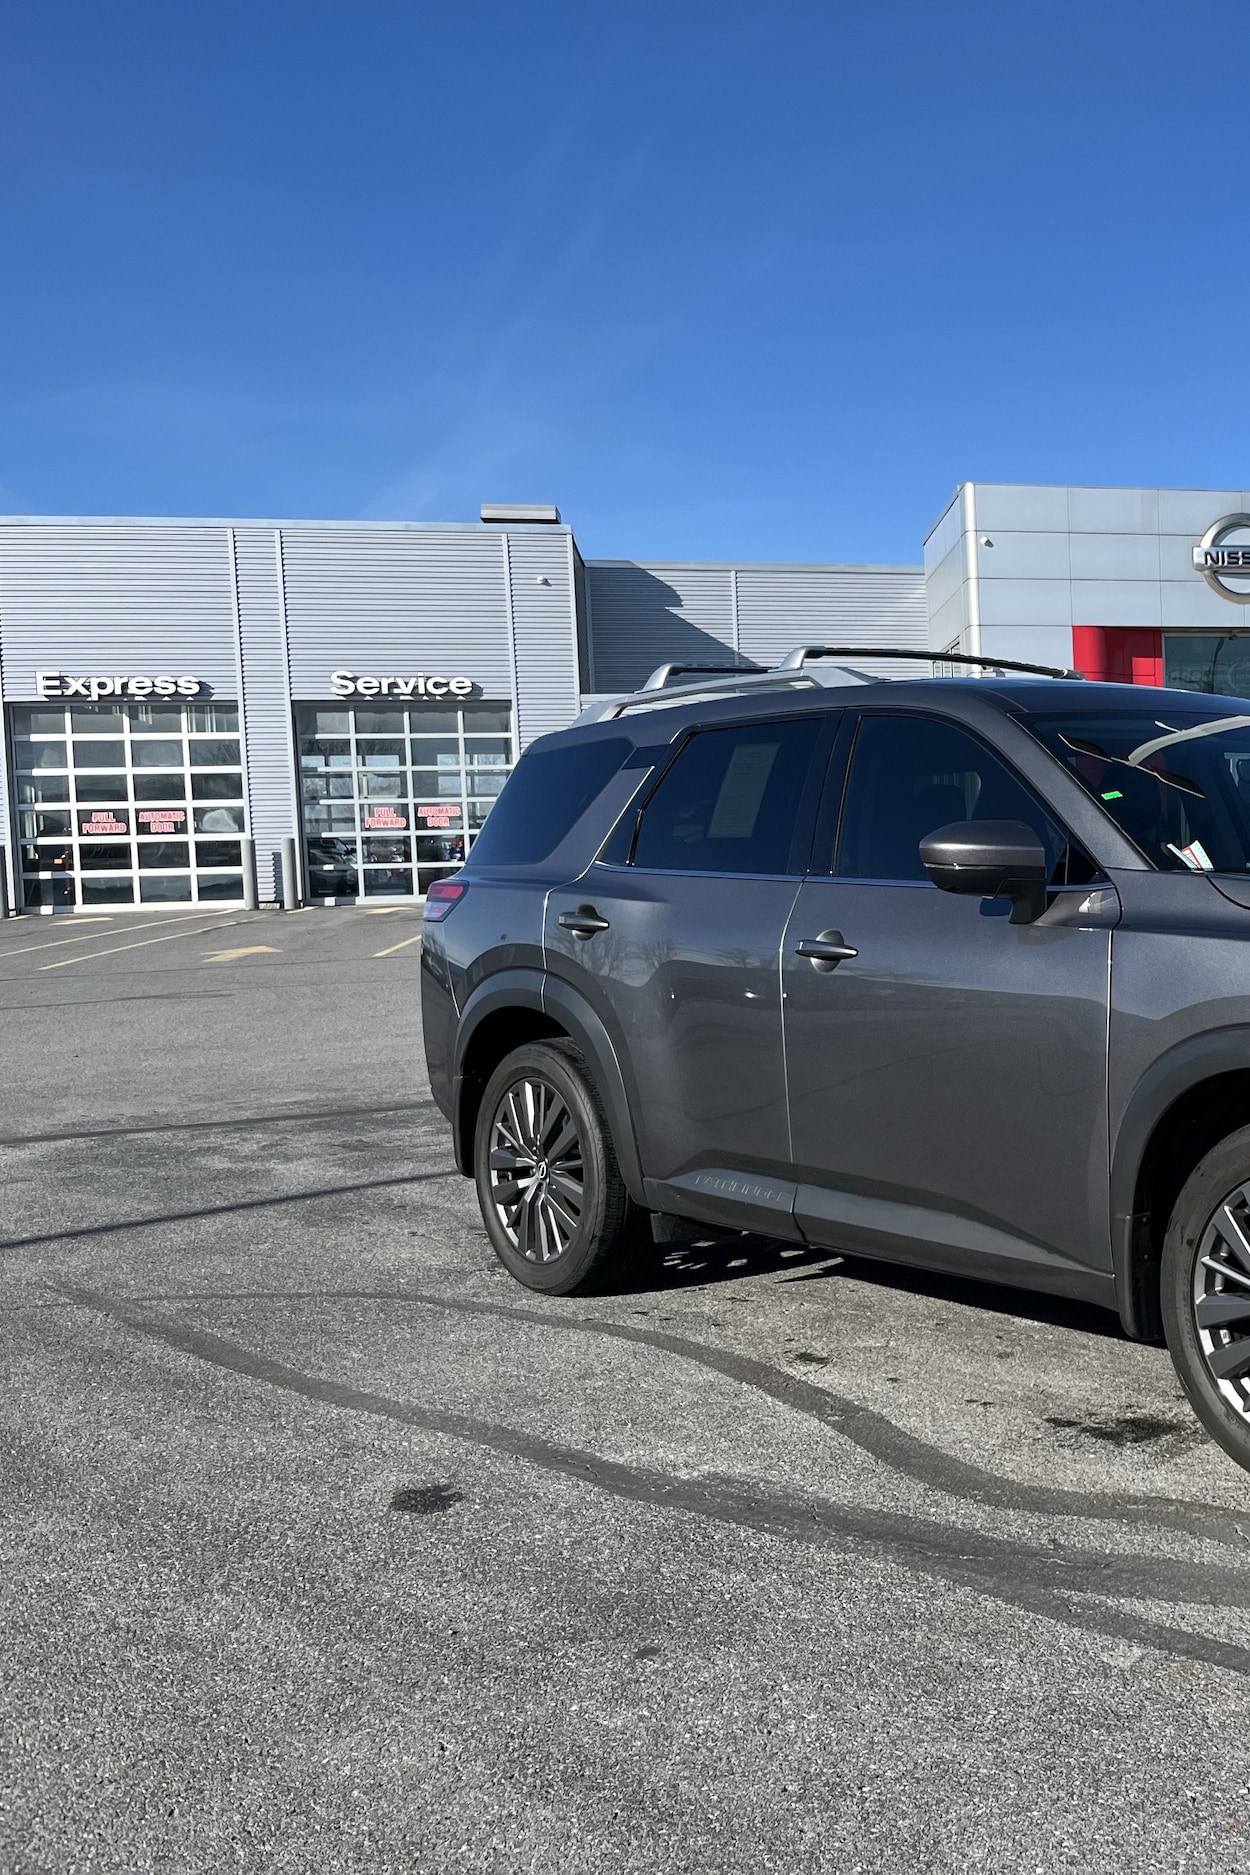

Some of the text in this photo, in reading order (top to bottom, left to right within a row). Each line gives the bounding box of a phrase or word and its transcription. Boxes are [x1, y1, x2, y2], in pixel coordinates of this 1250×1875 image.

[35, 671, 200, 701] Express
[330, 670, 472, 695] Service
[139, 811, 185, 822] AUTOMATIC
[375, 808, 396, 817] PULL
[418, 806, 460, 817] AUTOMATIC
[92, 812, 115, 822] PULL
[428, 817, 449, 826] DOOR
[83, 823, 126, 833] FORWARD
[151, 822, 174, 832] DOOR
[365, 818, 406, 828] FORWARD
